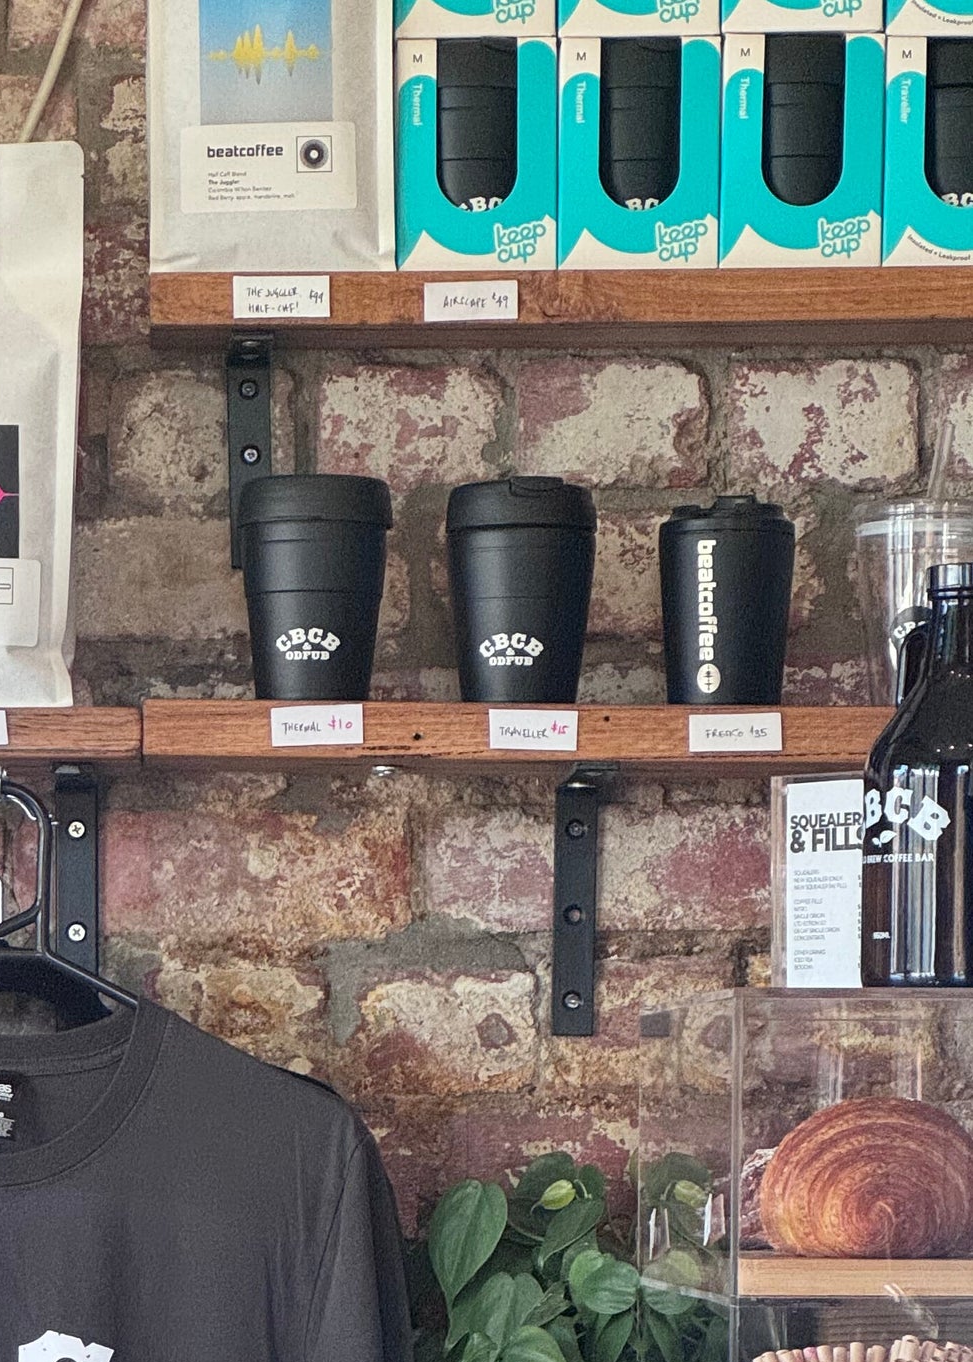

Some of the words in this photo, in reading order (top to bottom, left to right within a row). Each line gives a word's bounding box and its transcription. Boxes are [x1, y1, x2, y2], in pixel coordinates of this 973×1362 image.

[496, 3, 535, 24] cup
[660, 3, 699, 24] cup
[413, 54, 423, 63] M
[576, 52, 587, 61] M
[740, 47, 751, 57] M
[902, 49, 912, 59] M
[412, 83, 423, 126] Thermal
[576, 81, 587, 124] Thermal
[739, 76, 751, 119] Thermal
[900, 79, 912, 124] Traveller
[207, 144, 283, 158] beatcoffee
[496, 223, 546, 249] keep
[657, 222, 708, 247] keep
[820, 219, 871, 243] keep
[497, 243, 536, 264] cup
[659, 241, 698, 263] cup
[821, 237, 860, 259] cup
[907, 233, 934, 254] Insulated
[938, 251, 971, 262] Leakproof
[246, 286, 263, 298] THE
[698, 539, 718, 661] beatcoffee
[276, 628, 341, 652] CBCB
[479, 632, 544, 657] CBCB
[285, 651, 330, 660] ODFUB
[489, 656, 533, 666] ODFUB
[282, 721, 322, 735] THERMAL
[790, 829, 806, 853] &
[883, 852, 913, 862] COFFEE
[915, 852, 934, 862] BAR
